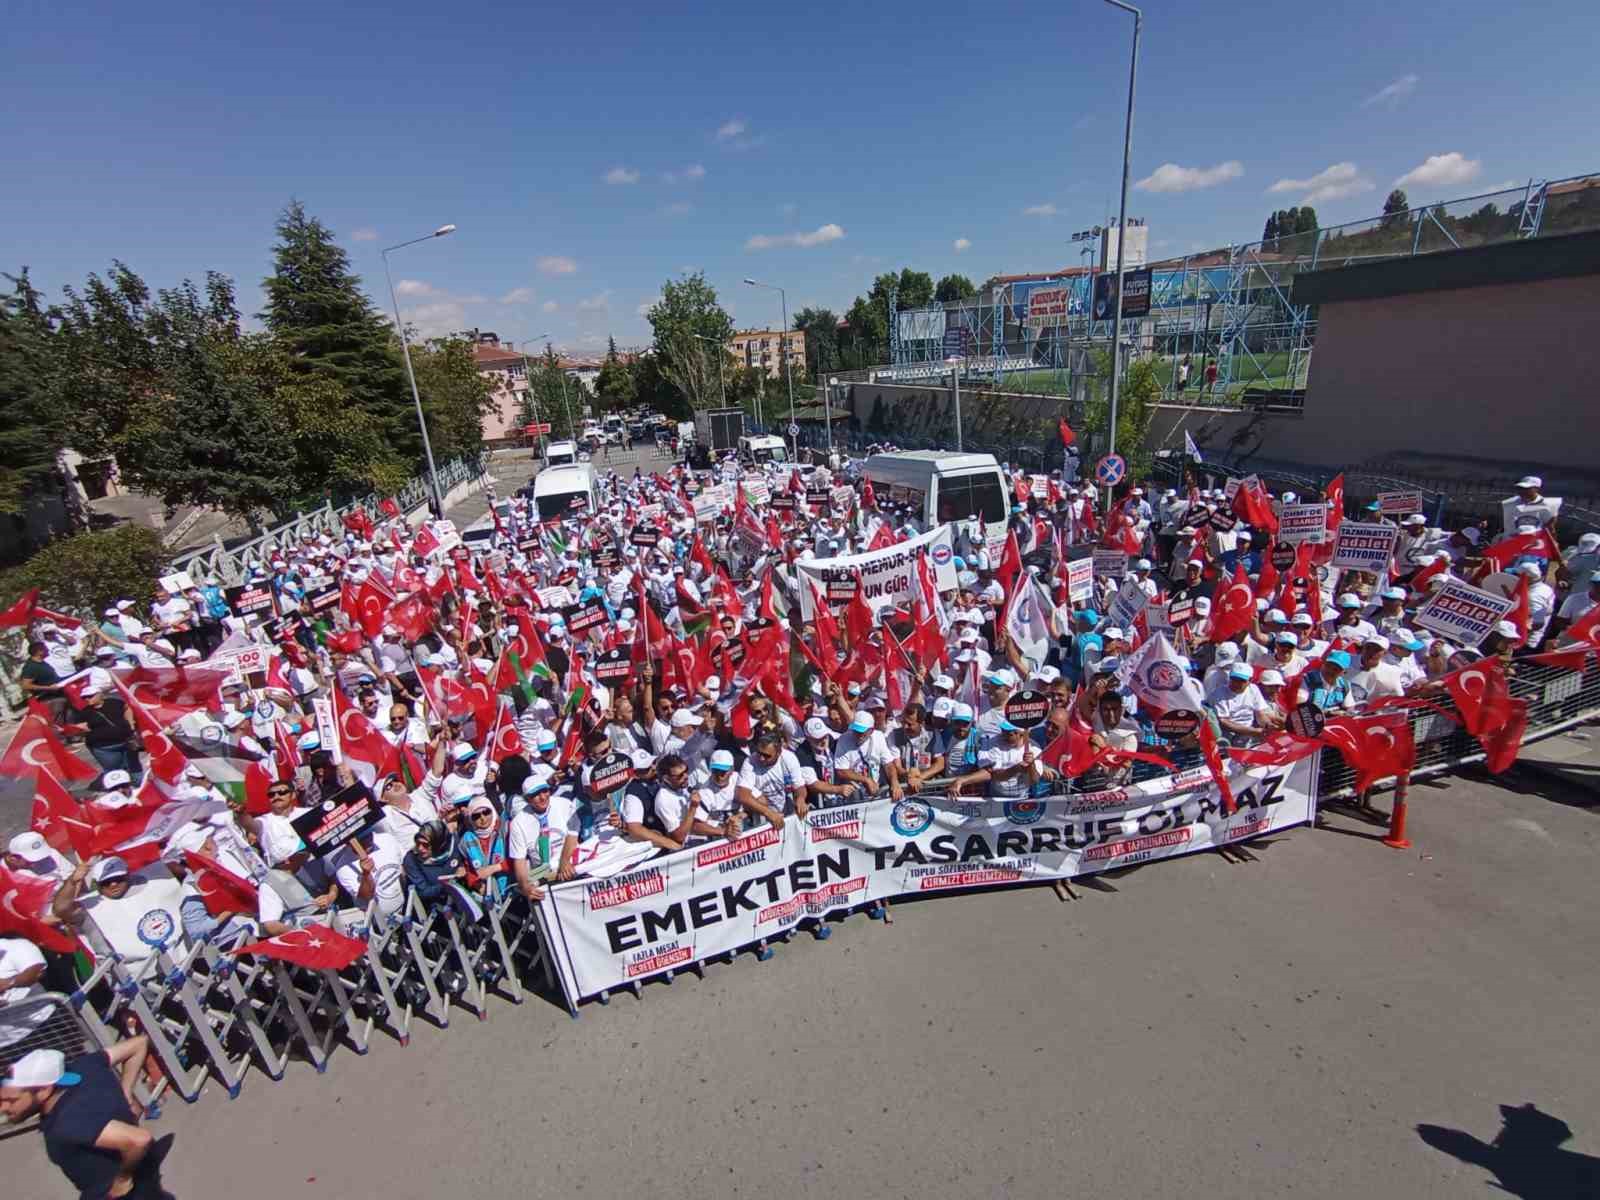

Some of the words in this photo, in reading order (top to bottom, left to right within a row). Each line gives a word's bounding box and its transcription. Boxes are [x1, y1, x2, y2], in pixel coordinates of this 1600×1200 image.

[884, 574, 909, 596] GÜR
[810, 808, 859, 827] SERVİSİME
[605, 848, 850, 955] EMEKTEN
[865, 817, 1124, 870] TASARRUF
